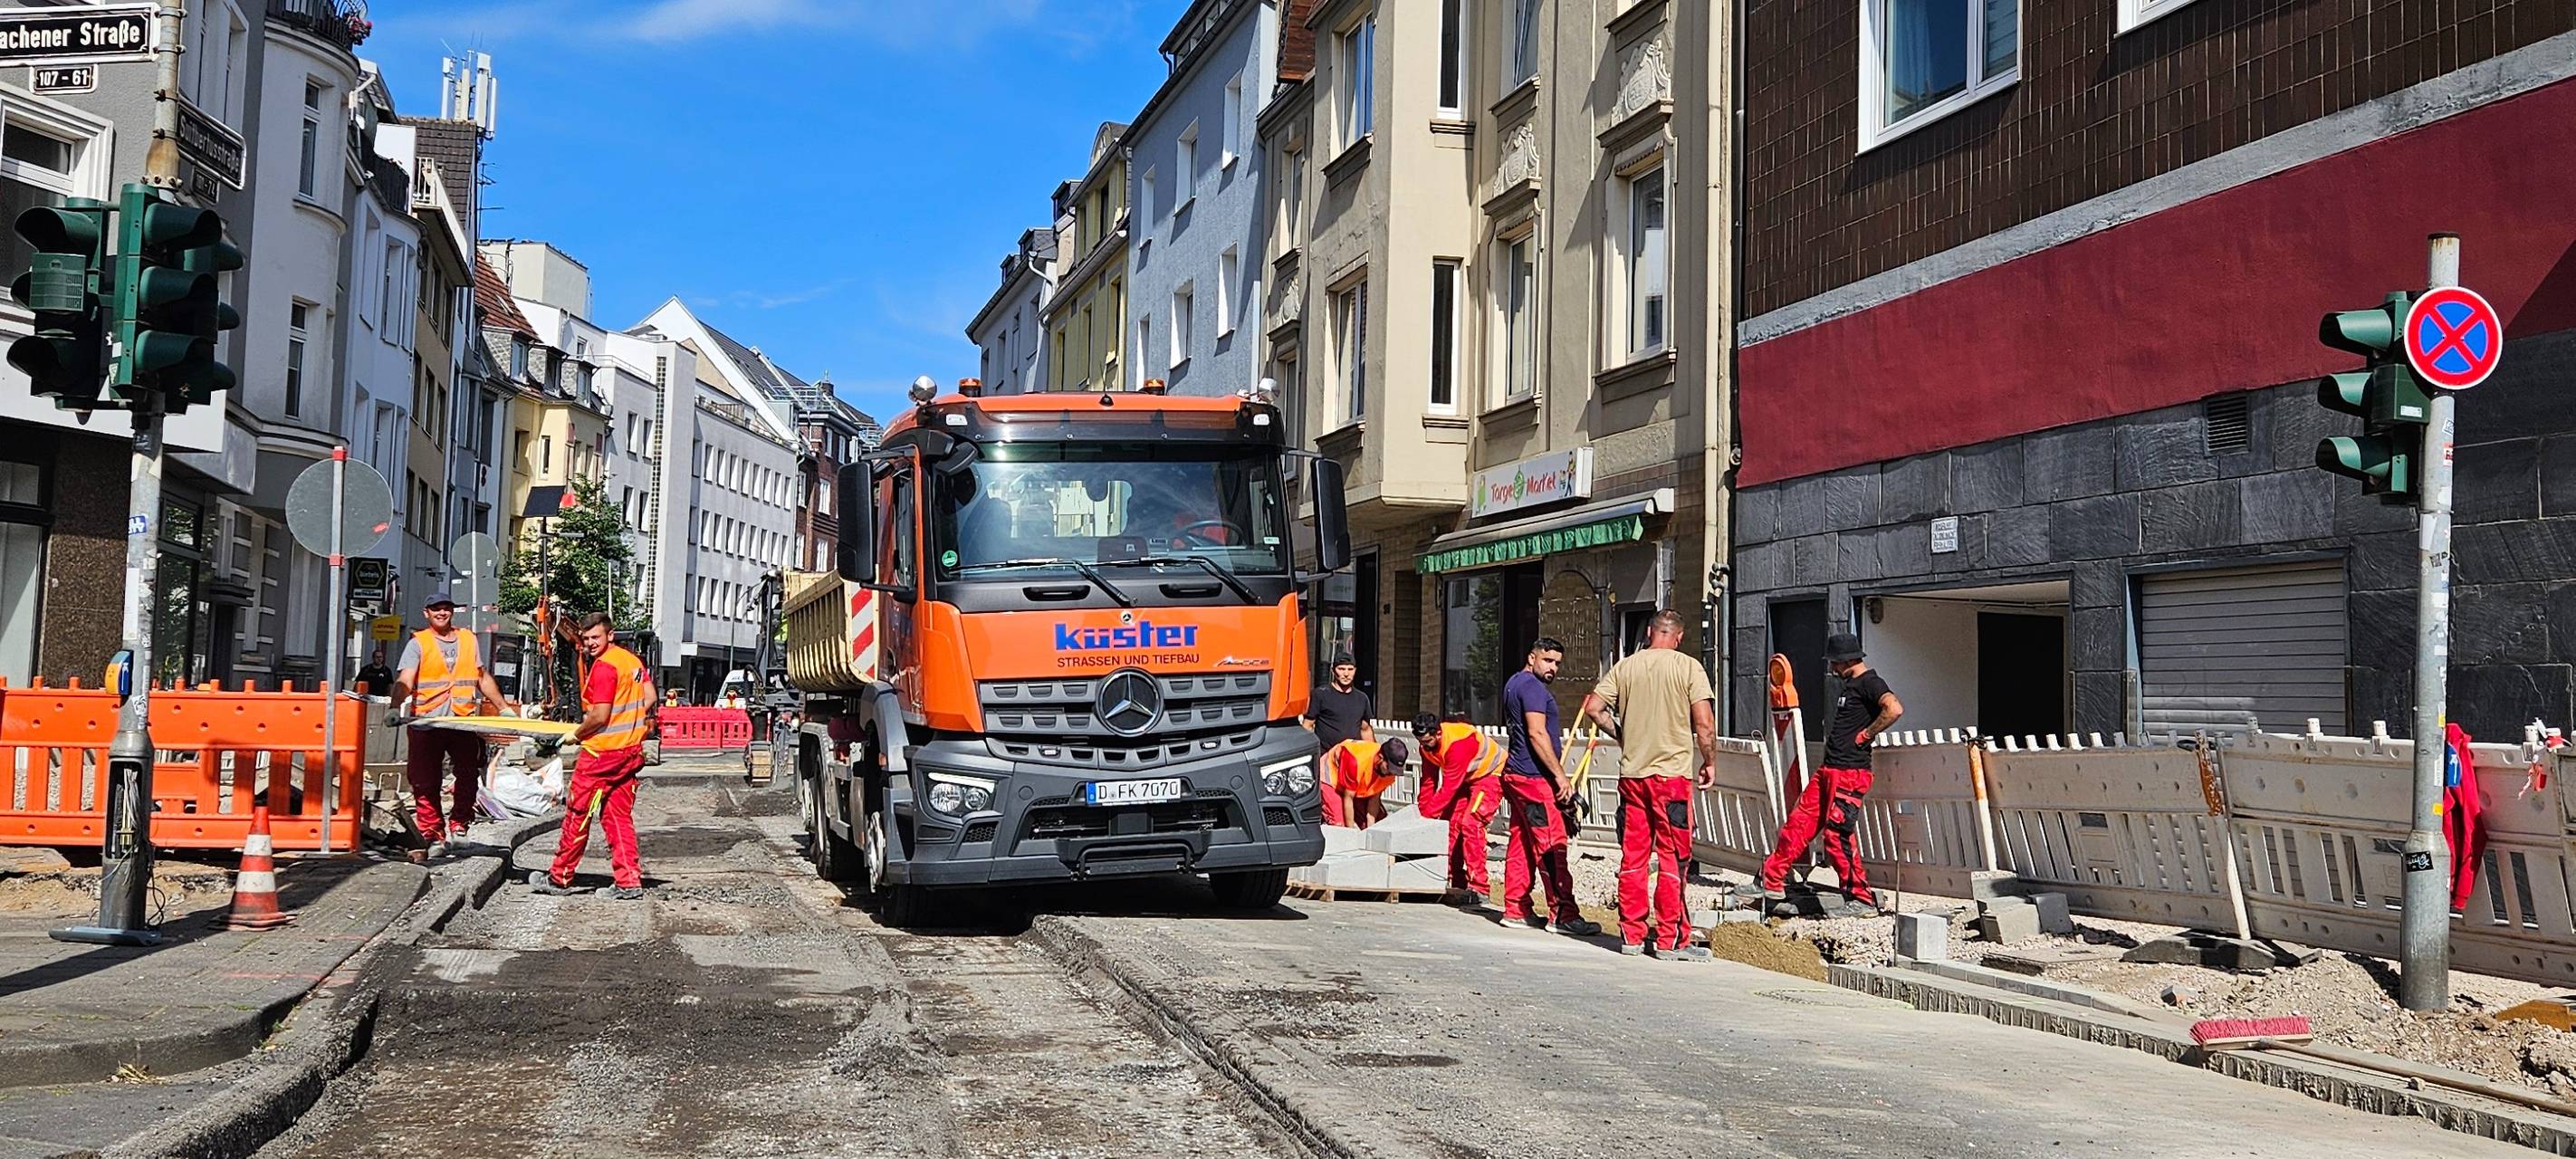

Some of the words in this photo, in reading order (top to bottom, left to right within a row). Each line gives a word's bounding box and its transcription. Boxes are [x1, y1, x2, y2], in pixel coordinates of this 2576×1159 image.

[80, 20, 140, 48] Straße
[39, 71, 59, 86] 107
[72, 70, 88, 86] 61
[1055, 620, 1199, 651] küster
[1058, 655, 1120, 668] STRASSEN
[1125, 653, 1149, 666] UND
[1153, 653, 1200, 665] TIEFBAU
[1098, 785, 1107, 800] D
[1118, 783, 1137, 799] FK
[1141, 781, 1178, 798] 7070
